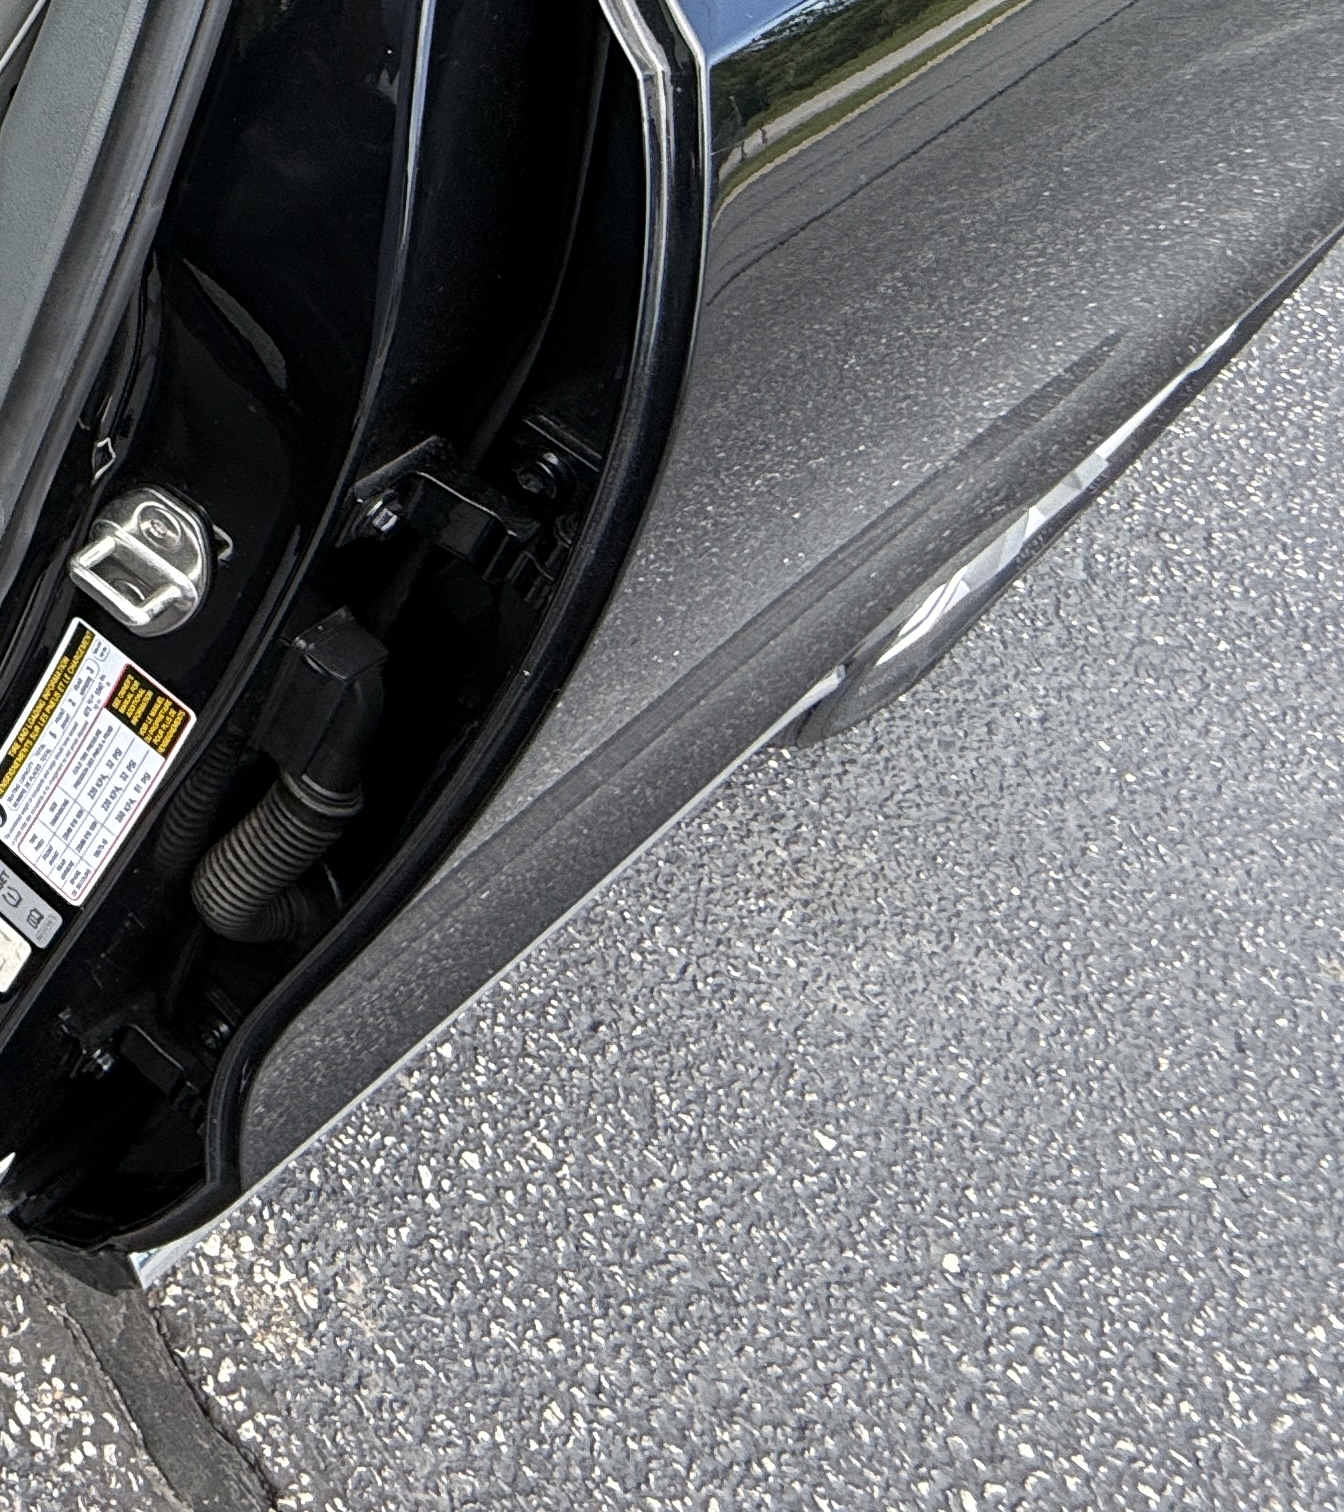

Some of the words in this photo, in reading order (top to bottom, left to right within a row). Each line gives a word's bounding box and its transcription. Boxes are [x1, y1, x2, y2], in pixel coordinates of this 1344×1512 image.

[67, 630, 94, 674] CHARGEMENT
[8, 741, 21, 756] TIRE
[17, 726, 29, 743] AND
[25, 698, 46, 729] LOADING
[41, 656, 69, 700] INFORMATION
